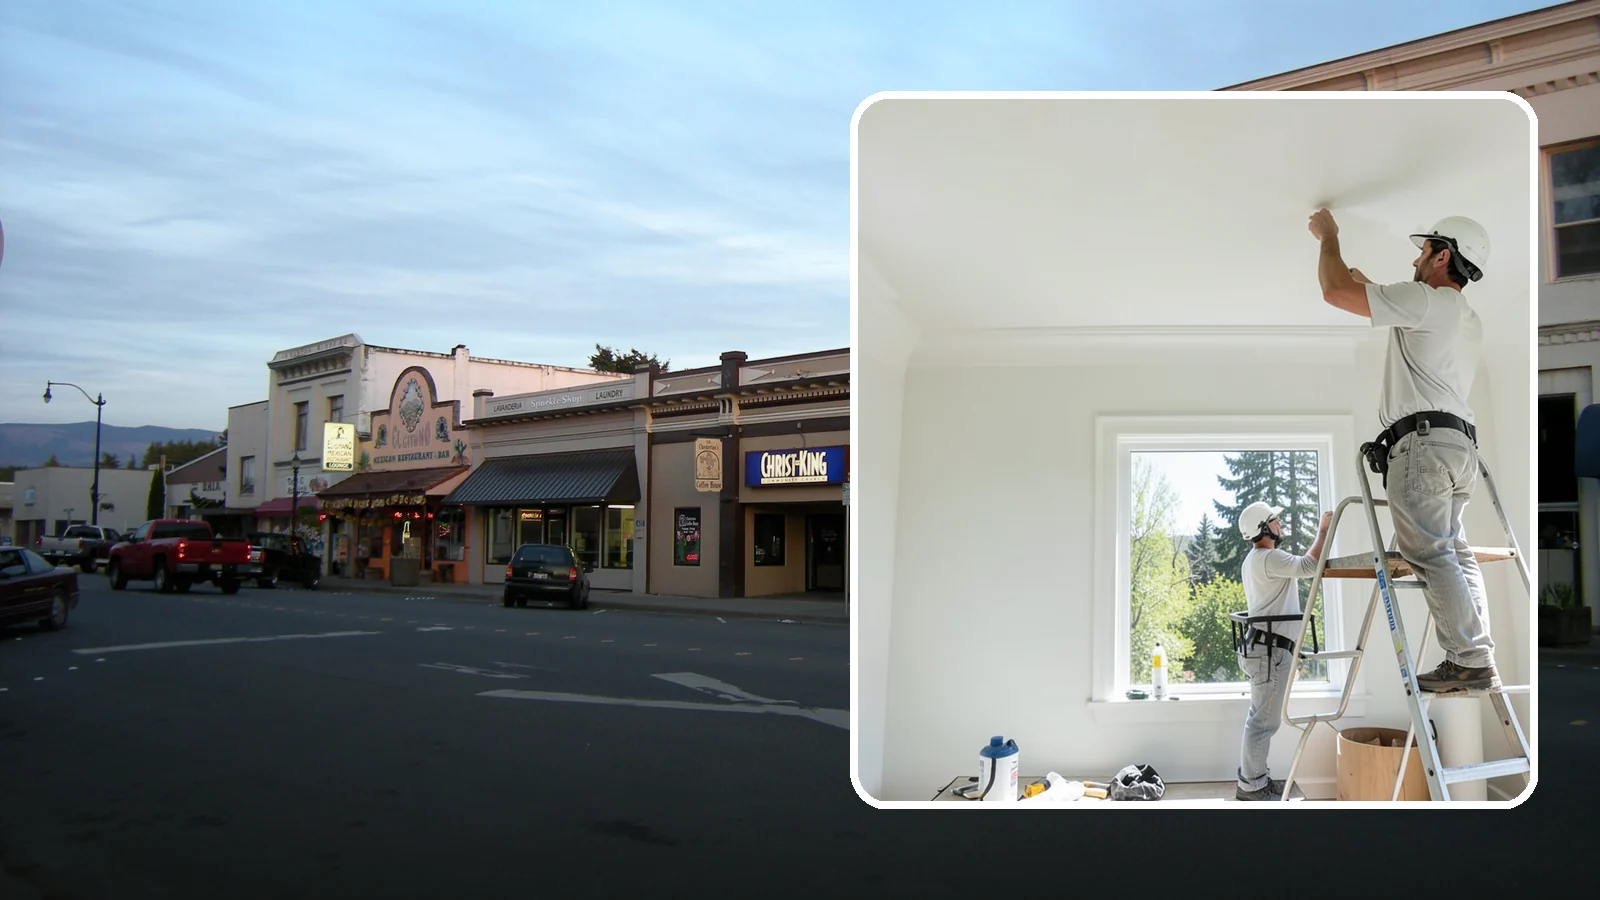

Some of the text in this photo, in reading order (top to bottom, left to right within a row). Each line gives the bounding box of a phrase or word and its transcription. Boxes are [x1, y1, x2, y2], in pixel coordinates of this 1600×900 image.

[530, 394, 583, 408] Sparkle Shop
[595, 389, 623, 400] LAUNDRY
[493, 402, 522, 413] LAVANDERIA
[374, 450, 450, 463] MEXICAN RESTAURANT BAR
[761, 452, 797, 477] CHRIST
[799, 450, 827, 477] KING
